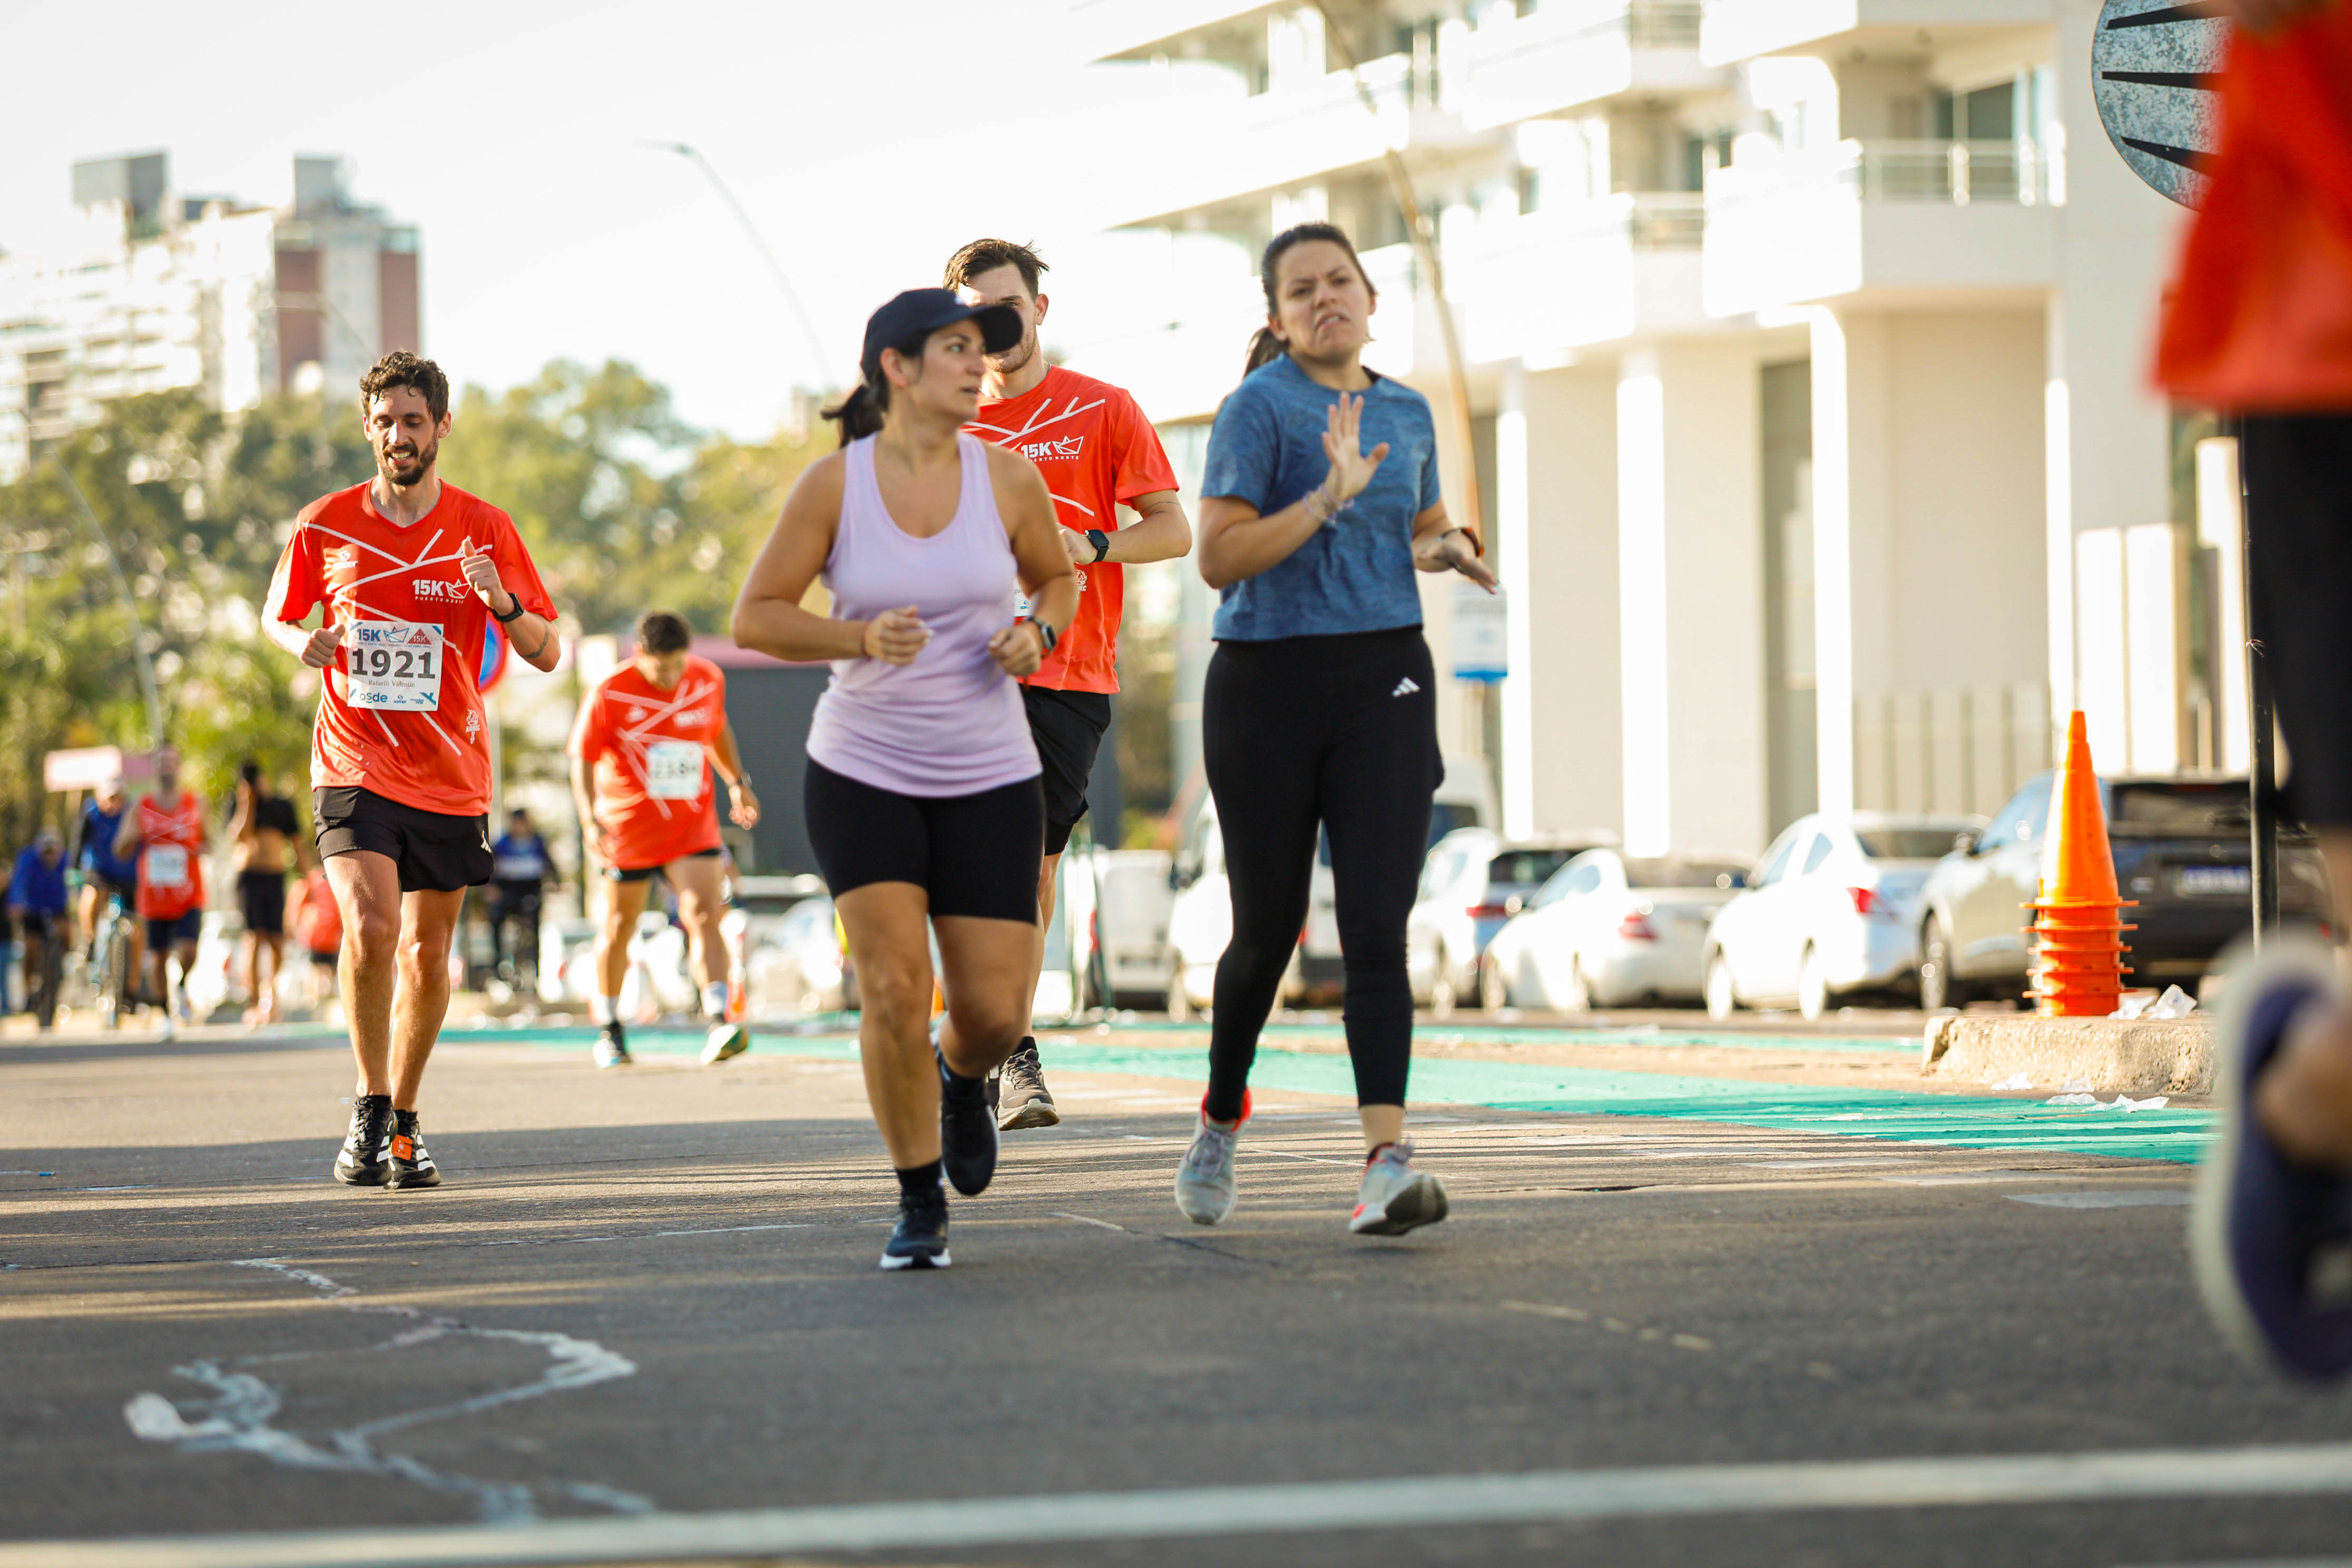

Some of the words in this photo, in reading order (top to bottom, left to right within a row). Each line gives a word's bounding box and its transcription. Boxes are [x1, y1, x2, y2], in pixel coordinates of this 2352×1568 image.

[1021, 442, 1052, 459] 15K
[413, 579, 445, 596] 15K
[357, 628, 381, 642] 15K
[352, 648, 436, 679] 1921
